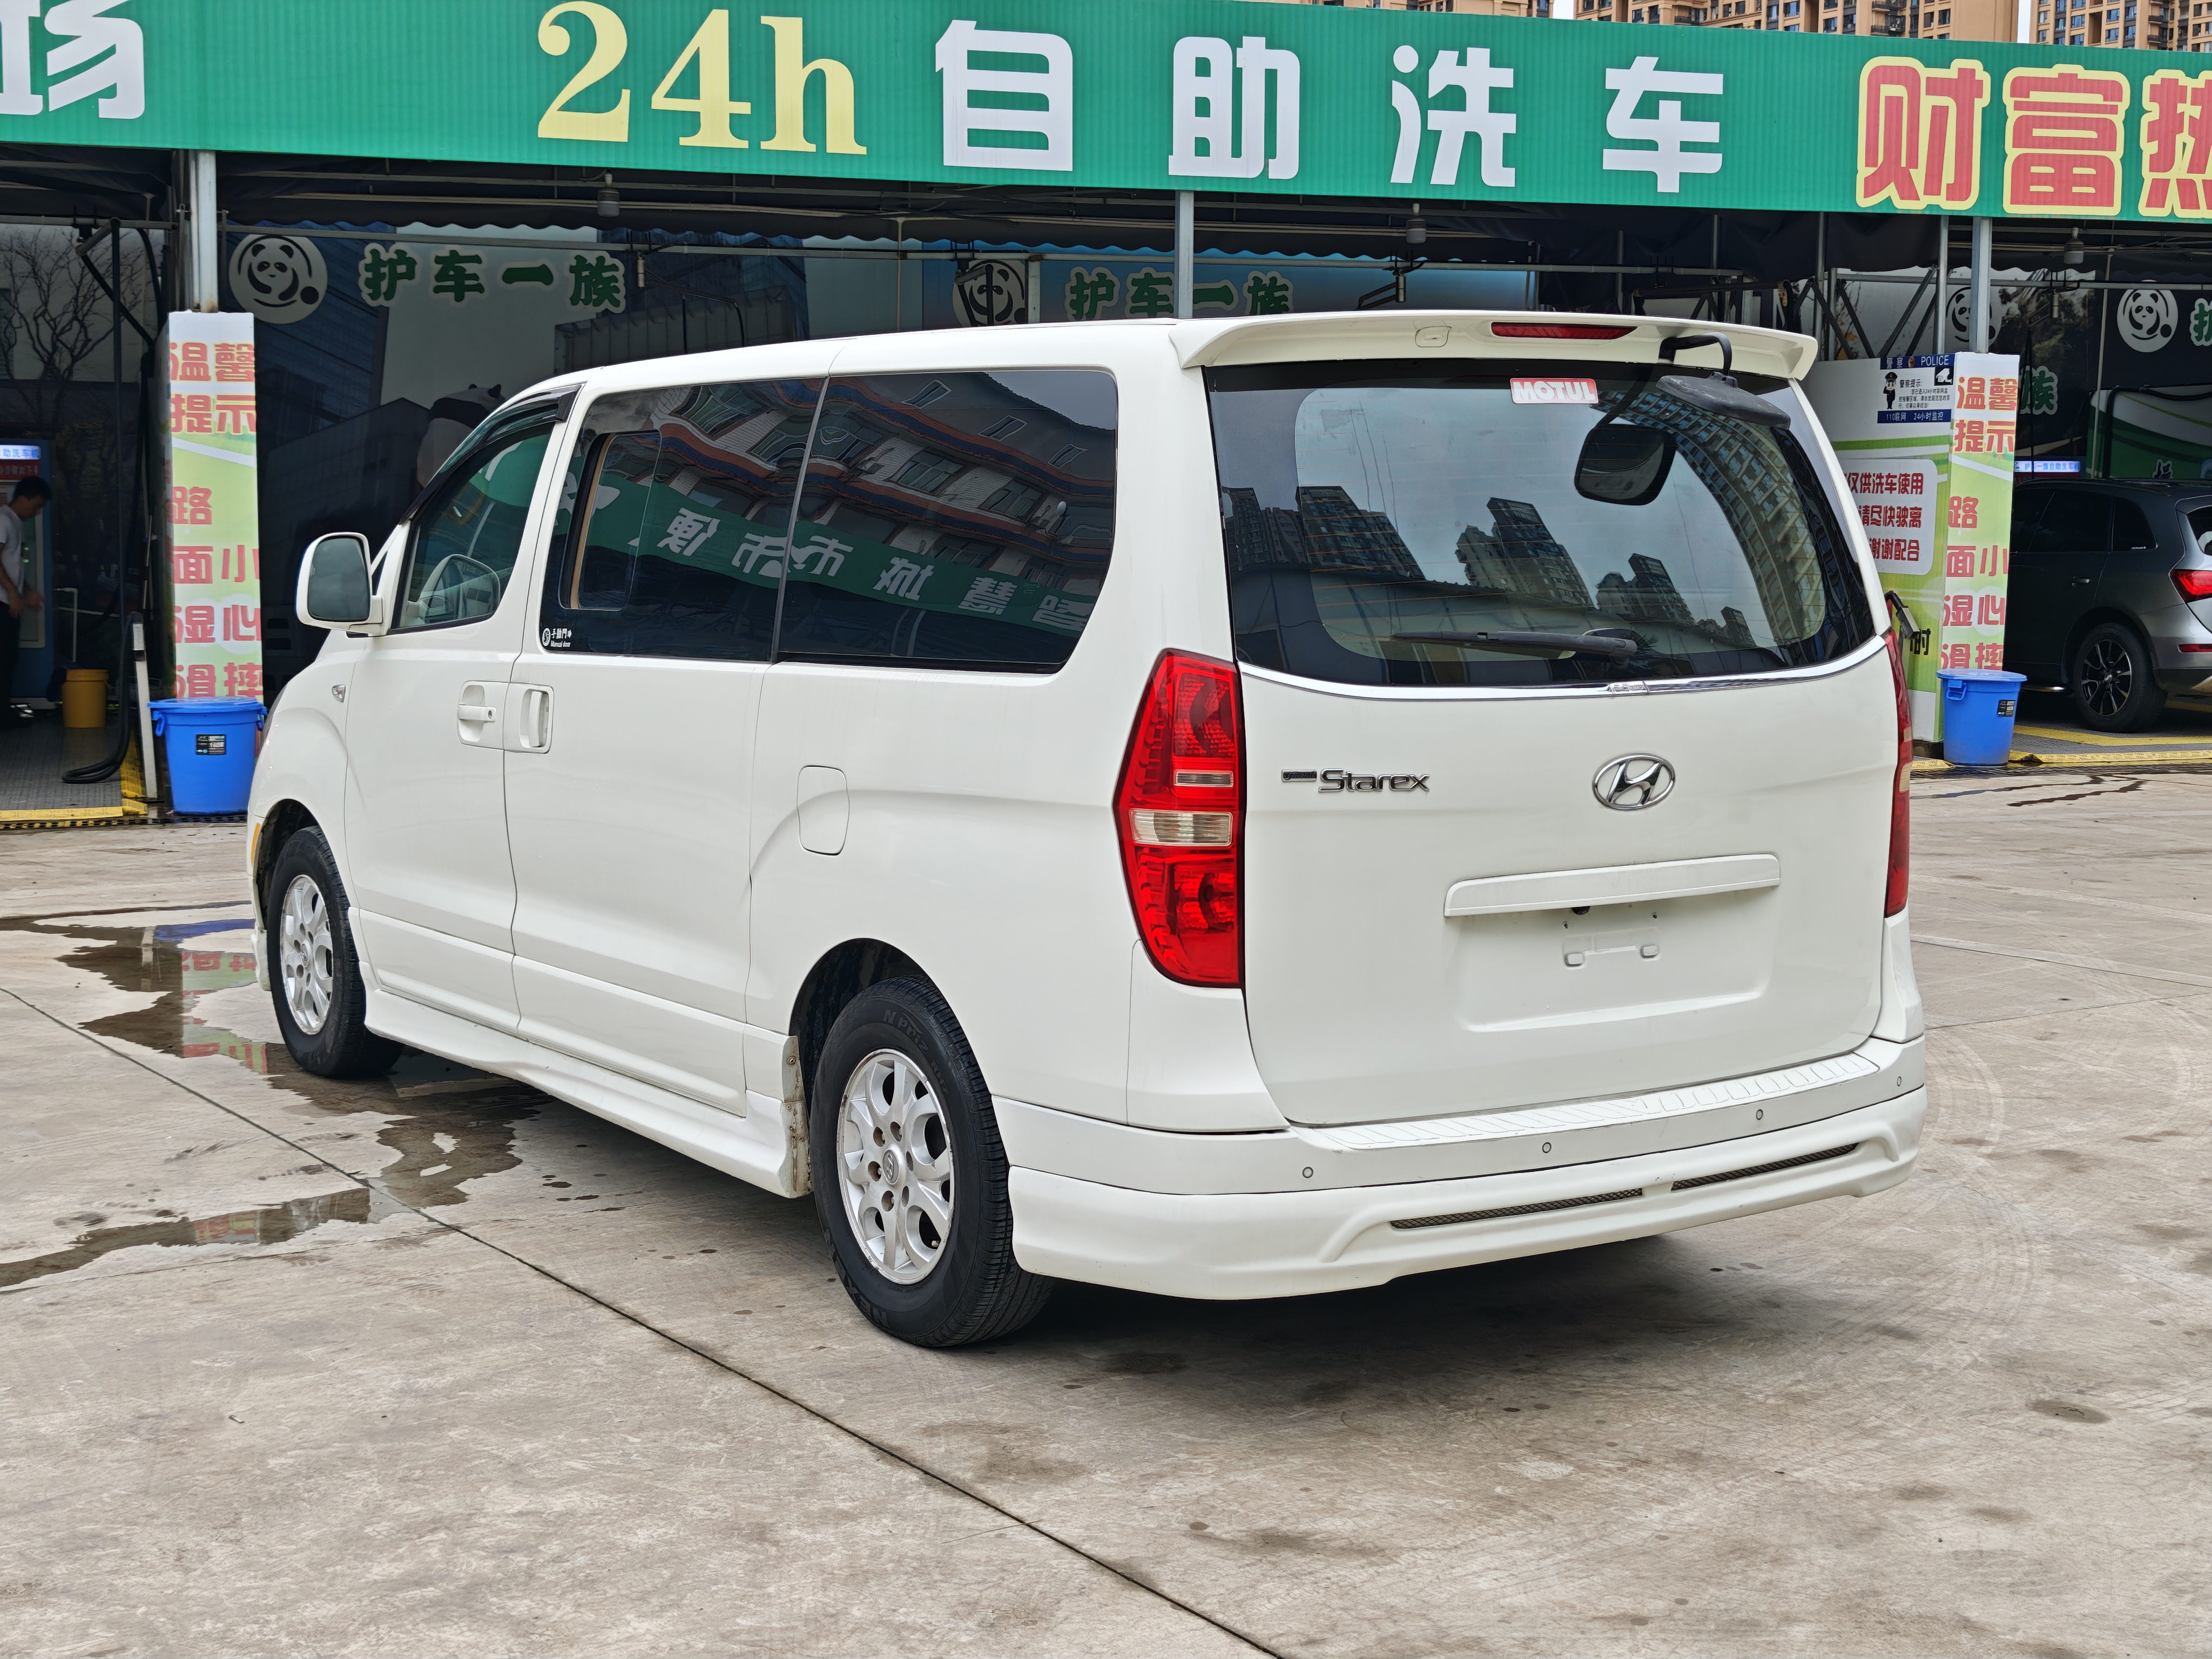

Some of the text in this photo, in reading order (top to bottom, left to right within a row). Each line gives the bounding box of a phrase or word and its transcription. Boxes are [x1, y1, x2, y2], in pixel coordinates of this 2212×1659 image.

[538, 1, 867, 155] 24h
[935, 20, 1724, 193] 自助洗车
[362, 247, 623, 310] 护车一族
[1068, 272, 1291, 319] 护车一族
[169, 342, 254, 381] 温馨
[1886, 357, 1903, 369] 警察
[1921, 355, 1949, 366] POLICE
[1513, 380, 1596, 401] MOTUL
[1956, 376, 2017, 411] 温馨
[171, 394, 256, 433] 提示
[1886, 412, 1944, 422] 110联网 24小时监控
[1954, 419, 2015, 453] 提示
[0, 449, 39, 457] 助洗车机
[1844, 473, 1924, 495] 仅供洗车使用
[1858, 505, 1923, 528] 请尽快驶离
[1870, 538, 1920, 562] 谢谢配合
[1318, 768, 1430, 792] Starex
